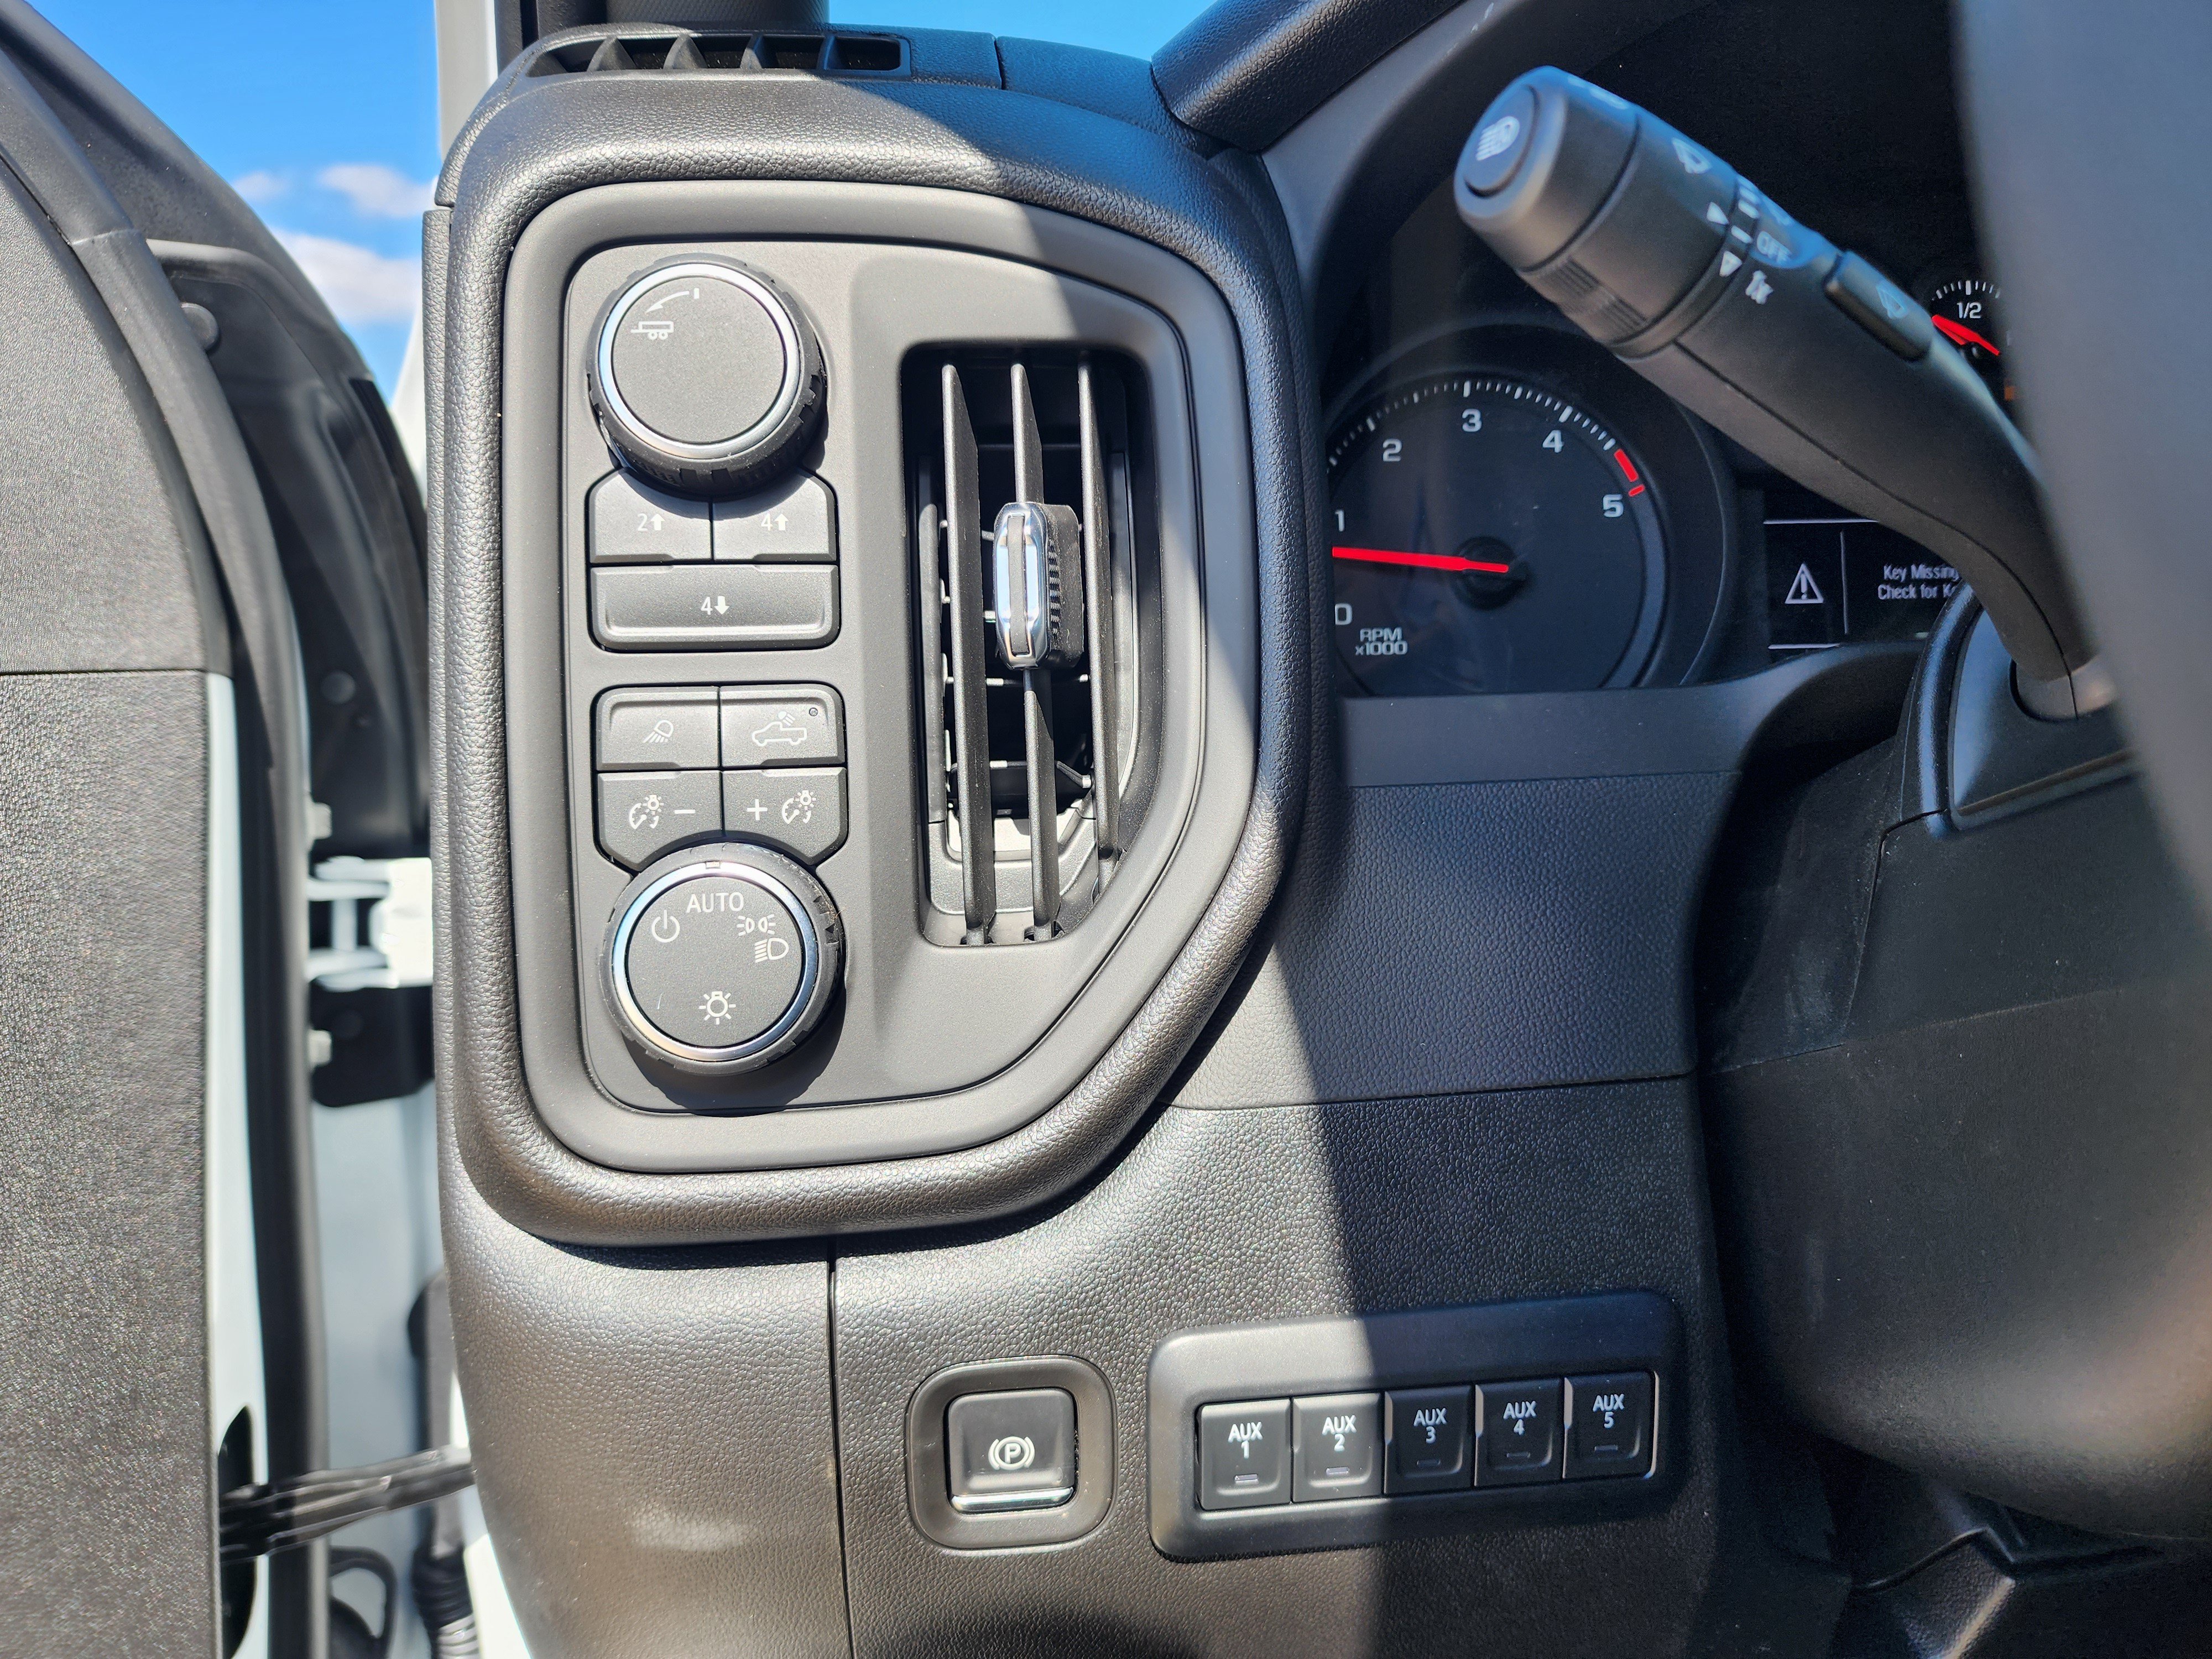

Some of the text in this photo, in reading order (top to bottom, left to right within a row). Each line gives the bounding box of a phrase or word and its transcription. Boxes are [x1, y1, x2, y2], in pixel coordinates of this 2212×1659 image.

[1757, 231, 1792, 265] OFF
[1957, 302, 1982, 319] 1/2
[1462, 409, 1482, 432] 3
[1382, 438, 1402, 462] 2
[1542, 430, 1564, 453] 4
[1603, 494, 1624, 518] 5
[1334, 508, 1345, 533] 1
[1884, 564, 1960, 582] Key Missing
[1877, 583, 1916, 600] Check
[1920, 583, 1938, 599] for
[1334, 603, 1353, 625] 0
[1360, 627, 1402, 642] RPM
[1355, 640, 1408, 656] x1000
[686, 891, 744, 913] AUTO
[1503, 1400, 1536, 1420] AUX
[1593, 1393, 1625, 1412] AUX
[1322, 1415, 1357, 1436] AUX
[1413, 1407, 1447, 1427] AUX
[1514, 1418, 1525, 1436] 4
[1604, 1411, 1614, 1429] 5
[1228, 1421, 1263, 1443] AUX
[1426, 1426, 1436, 1444] 3
[1240, 1440, 1250, 1459] 1
[1334, 1433, 1346, 1452] 2
